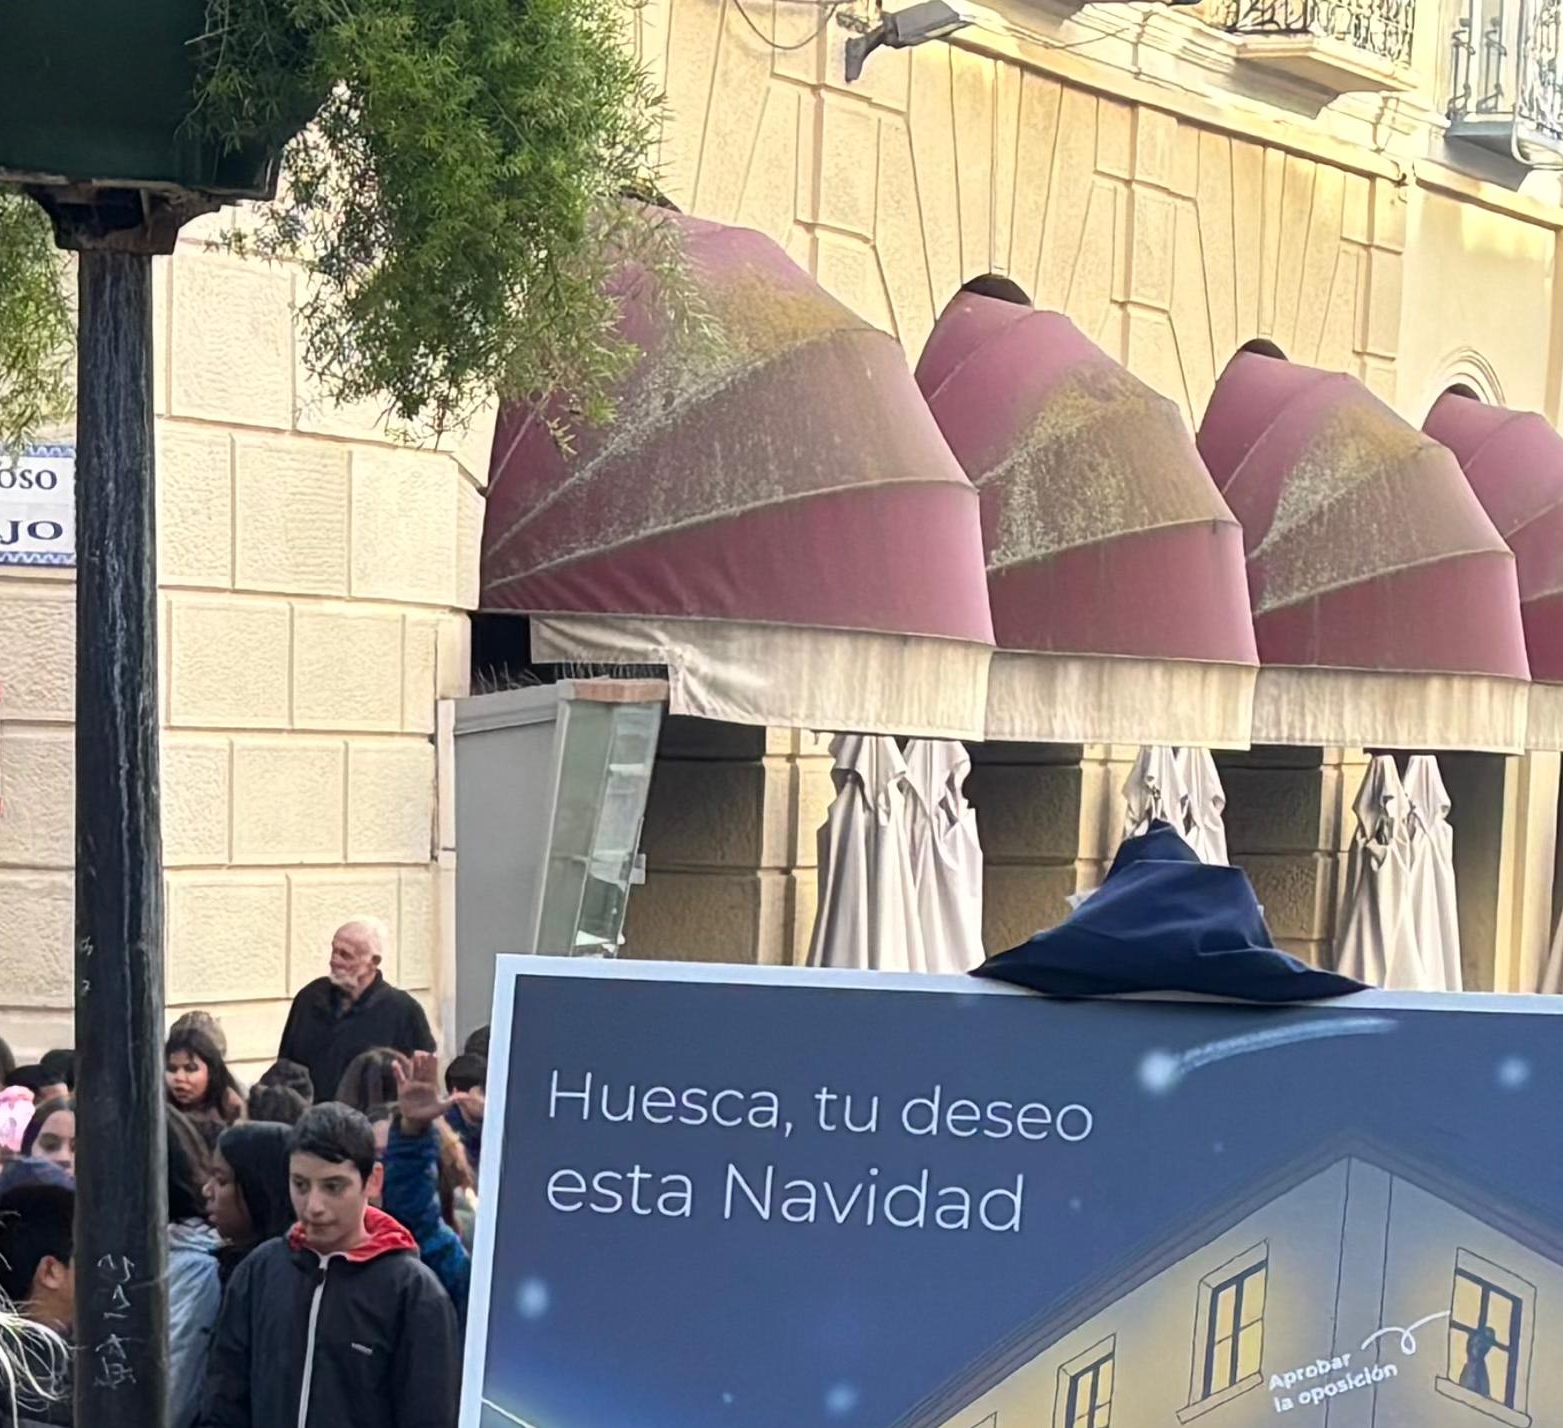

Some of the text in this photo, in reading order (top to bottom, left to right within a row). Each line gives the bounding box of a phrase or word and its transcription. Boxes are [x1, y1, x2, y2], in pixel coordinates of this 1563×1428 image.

[547, 1069, 1094, 1142] Huesca, tu deseo
[546, 1163, 1026, 1233] esta Navidad
[1269, 1353, 1352, 1391] Aprobar
[1273, 1363, 1398, 1413] la oposición
